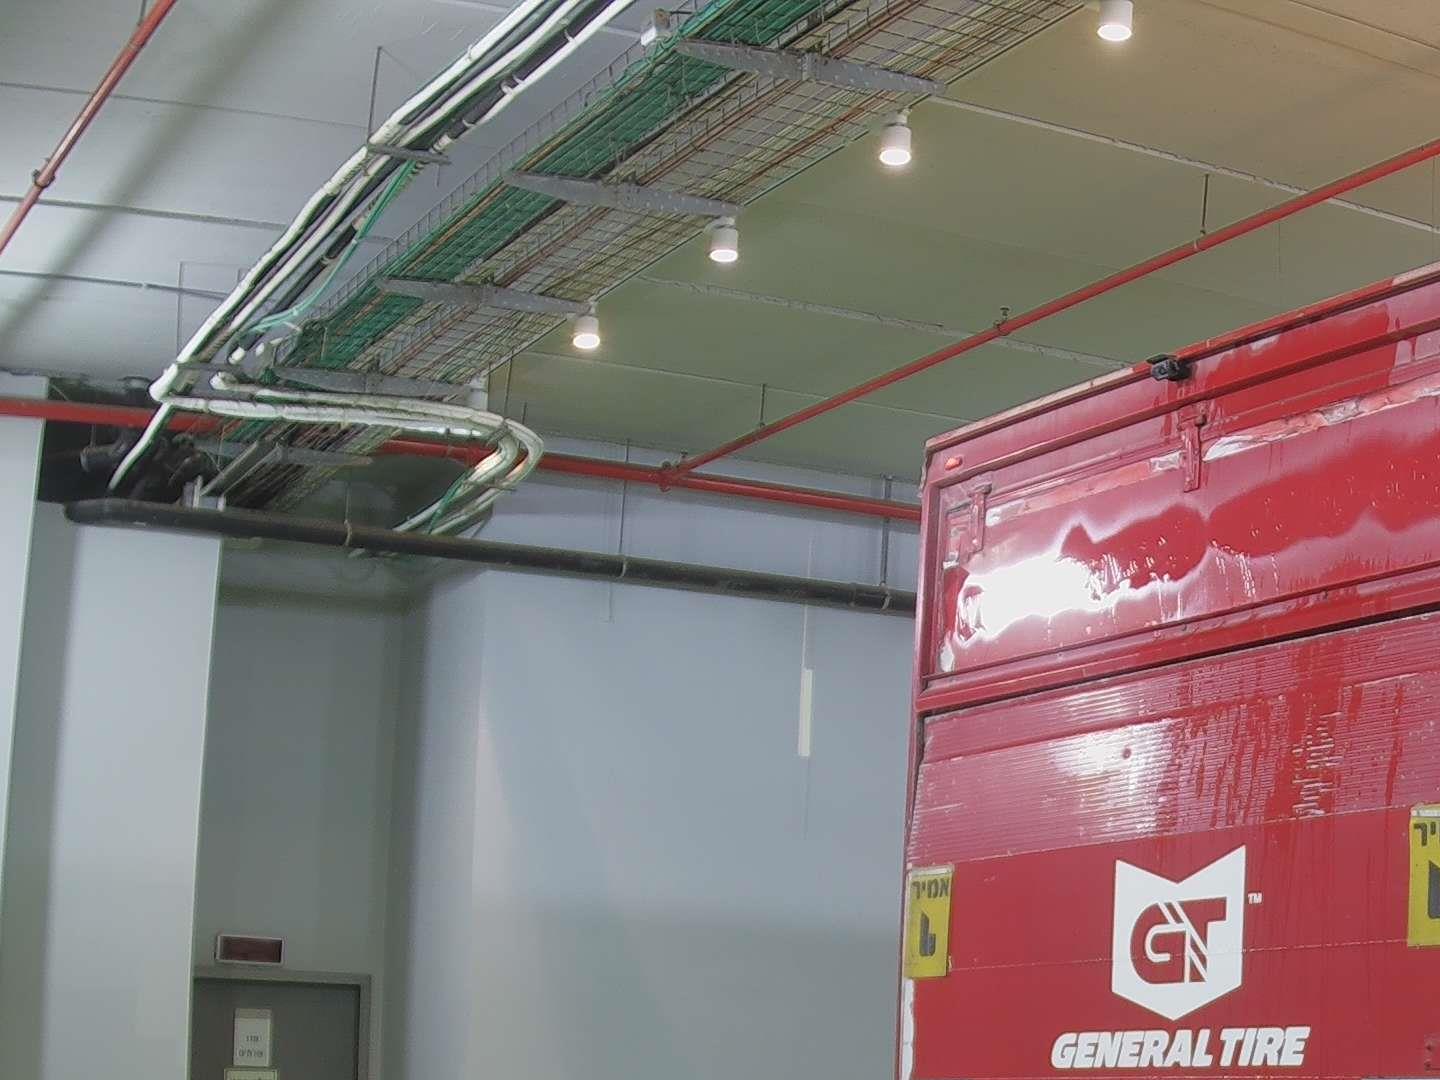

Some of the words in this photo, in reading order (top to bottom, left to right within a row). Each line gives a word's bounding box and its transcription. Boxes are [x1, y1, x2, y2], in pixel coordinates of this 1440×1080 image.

[911, 878, 950, 899] אמיר
[1050, 1028, 1213, 1069] GENERAL
[1219, 1026, 1311, 1068] TIRE
